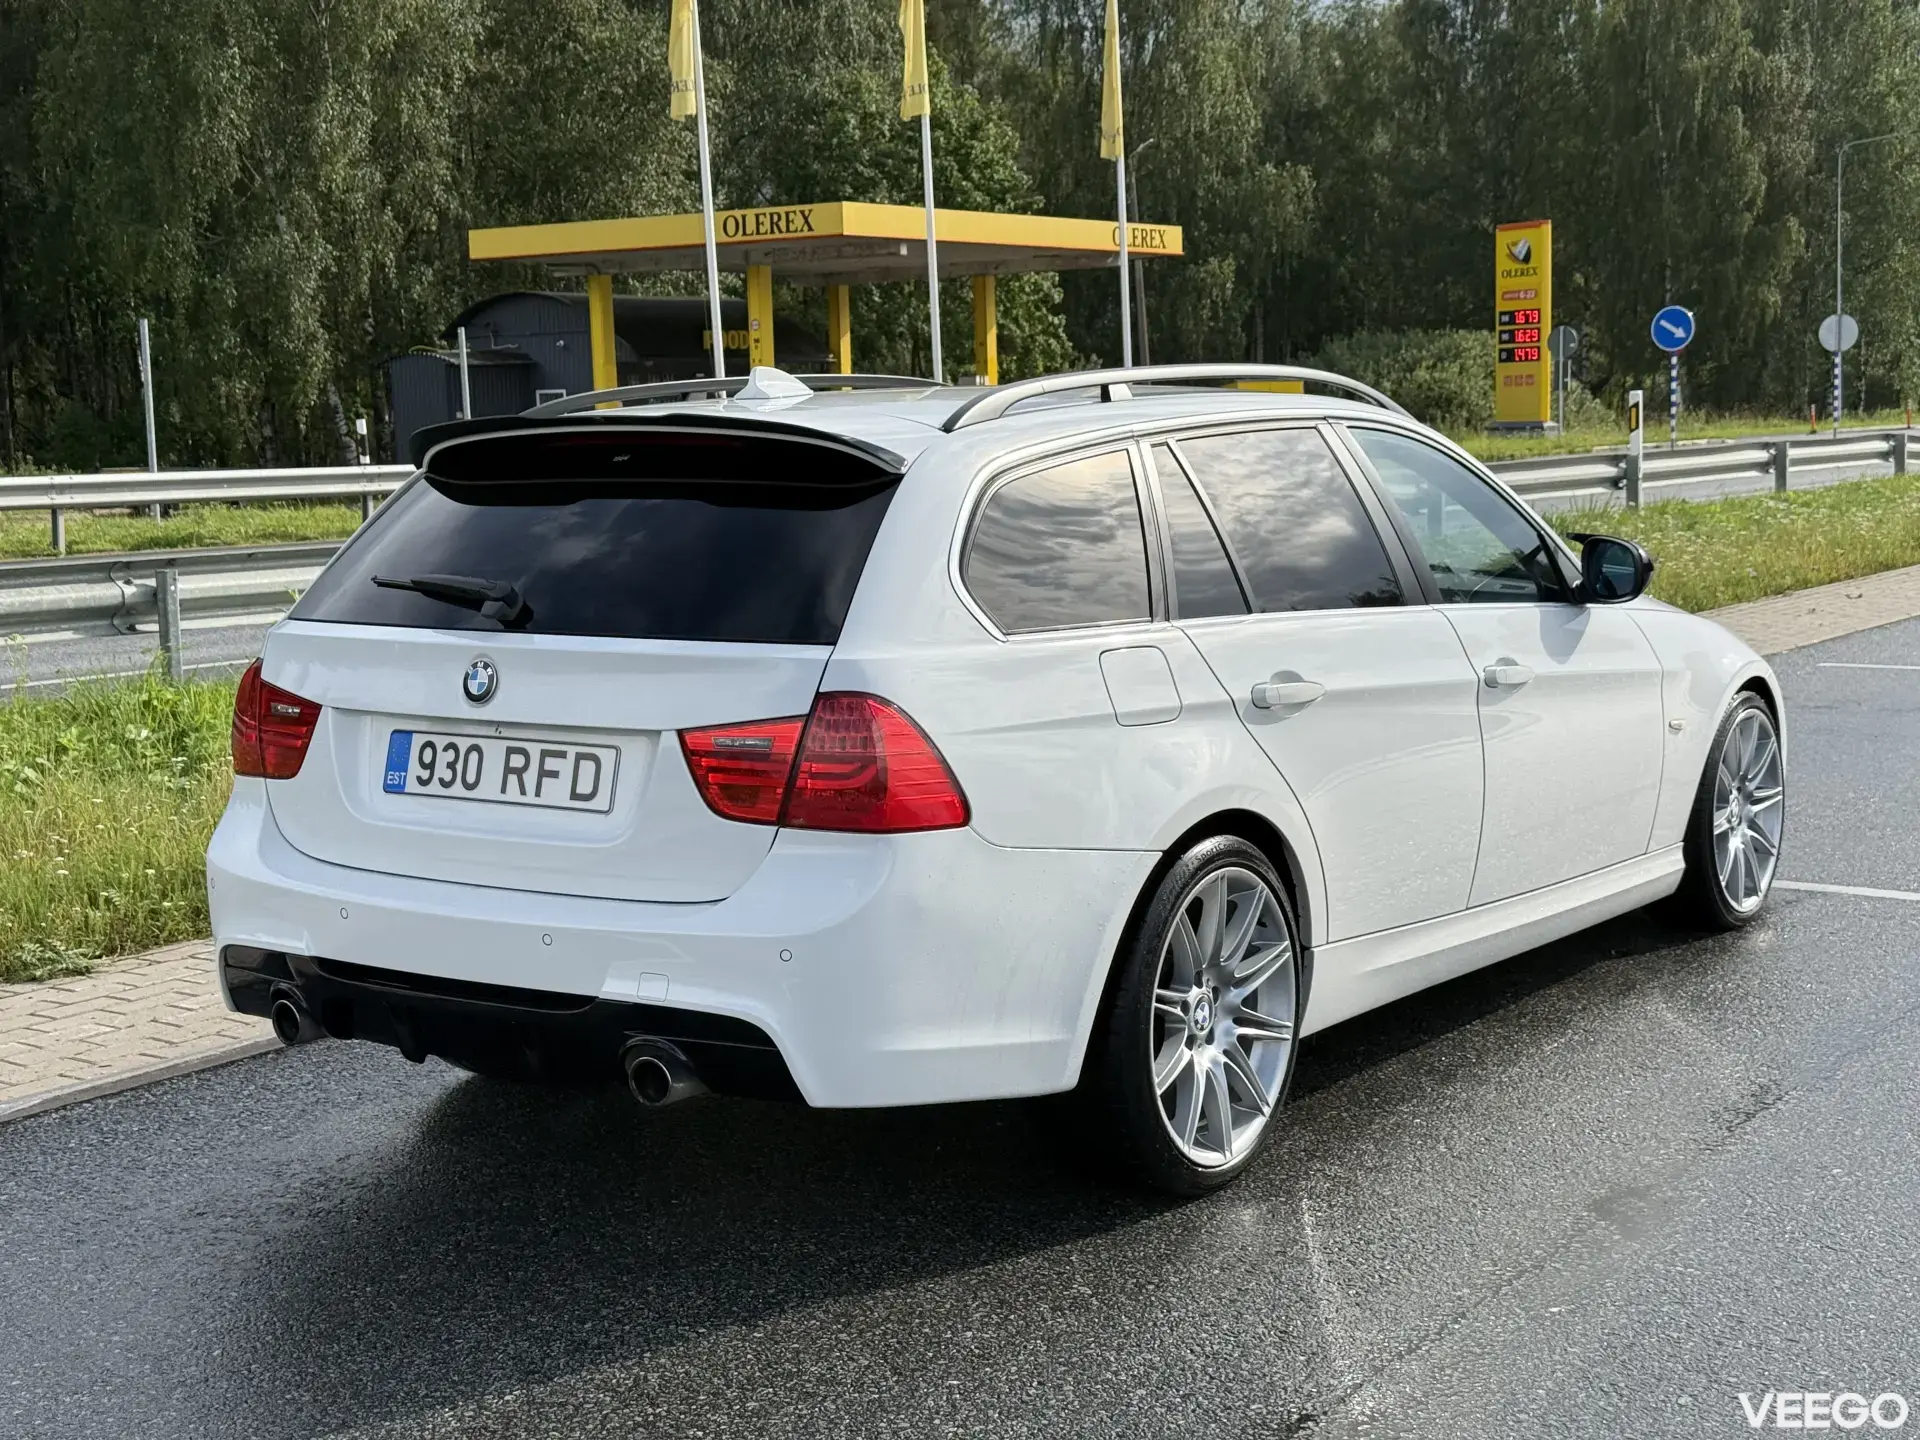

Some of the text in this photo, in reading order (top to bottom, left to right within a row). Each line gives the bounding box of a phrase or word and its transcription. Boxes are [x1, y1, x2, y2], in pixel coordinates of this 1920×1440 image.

[722, 208, 815, 238] OLEREX
[1501, 266, 1538, 279] OLEREX
[467, 661, 494, 676] BMW
[387, 771, 406, 786] EST
[416, 740, 603, 802] 930 RFD
